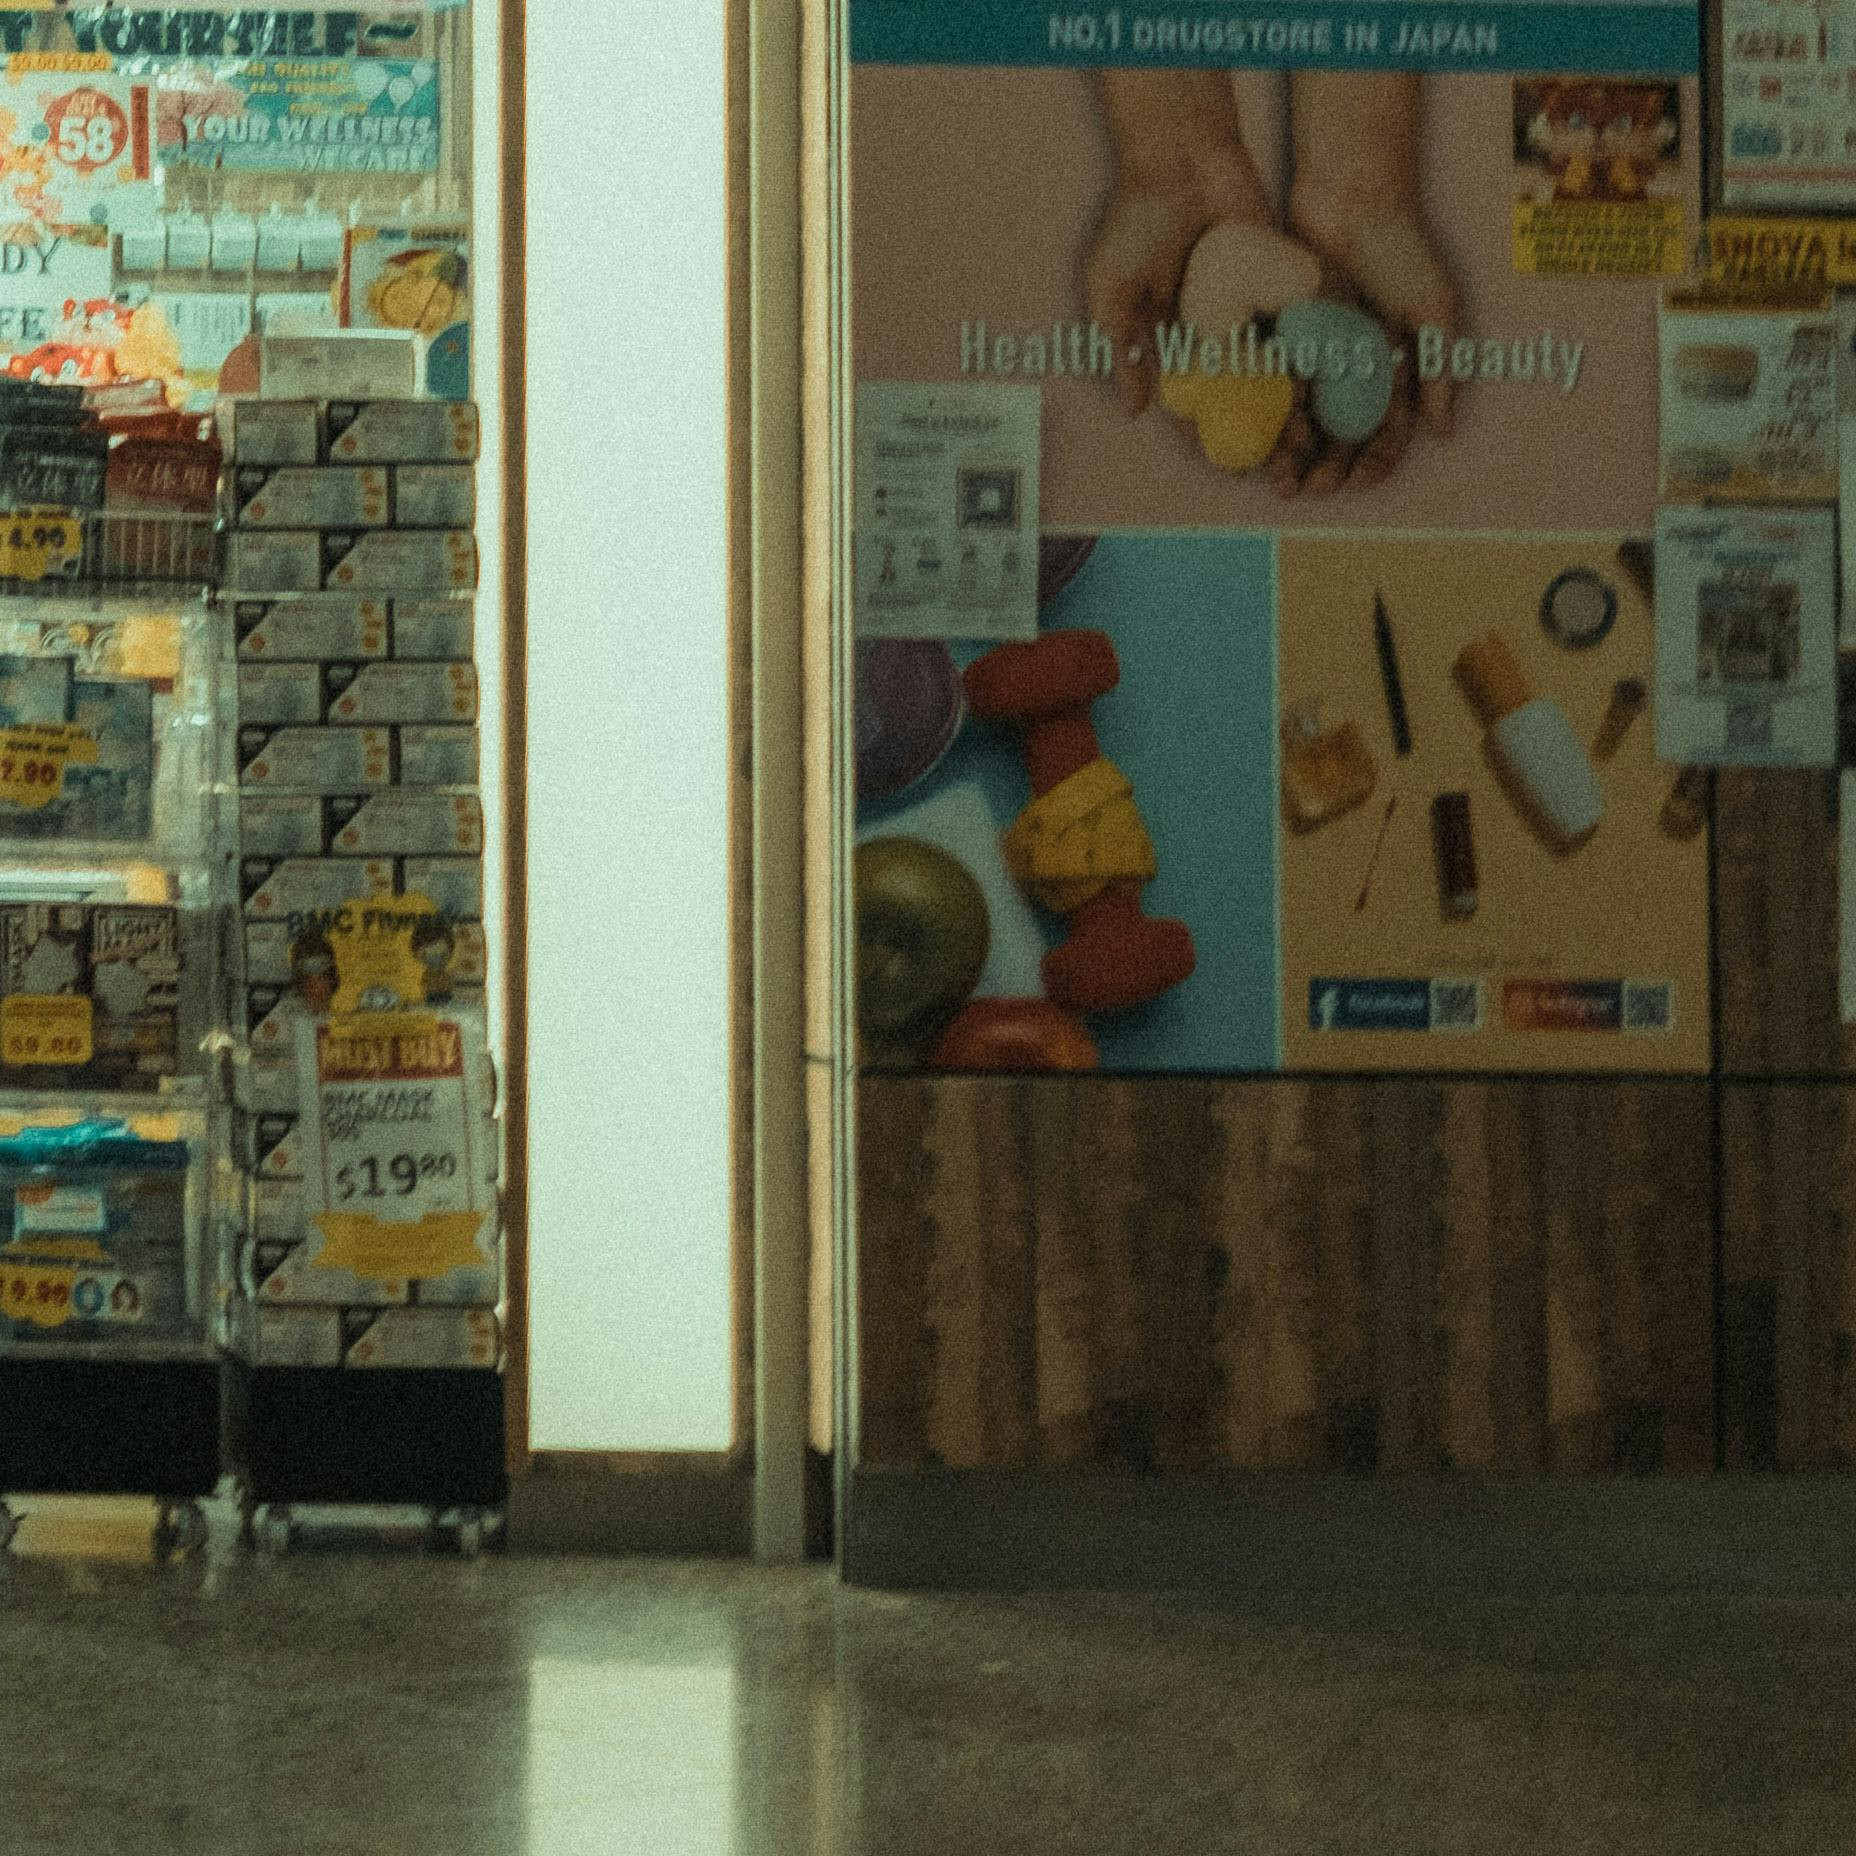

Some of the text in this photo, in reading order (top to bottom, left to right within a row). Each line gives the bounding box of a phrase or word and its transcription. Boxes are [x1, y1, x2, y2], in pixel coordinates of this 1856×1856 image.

[1047, 12, 1498, 56] NO.1 DRUGSTORE IN JAPAN
[959, 320, 1585, 394] Health Wellness Beauty
